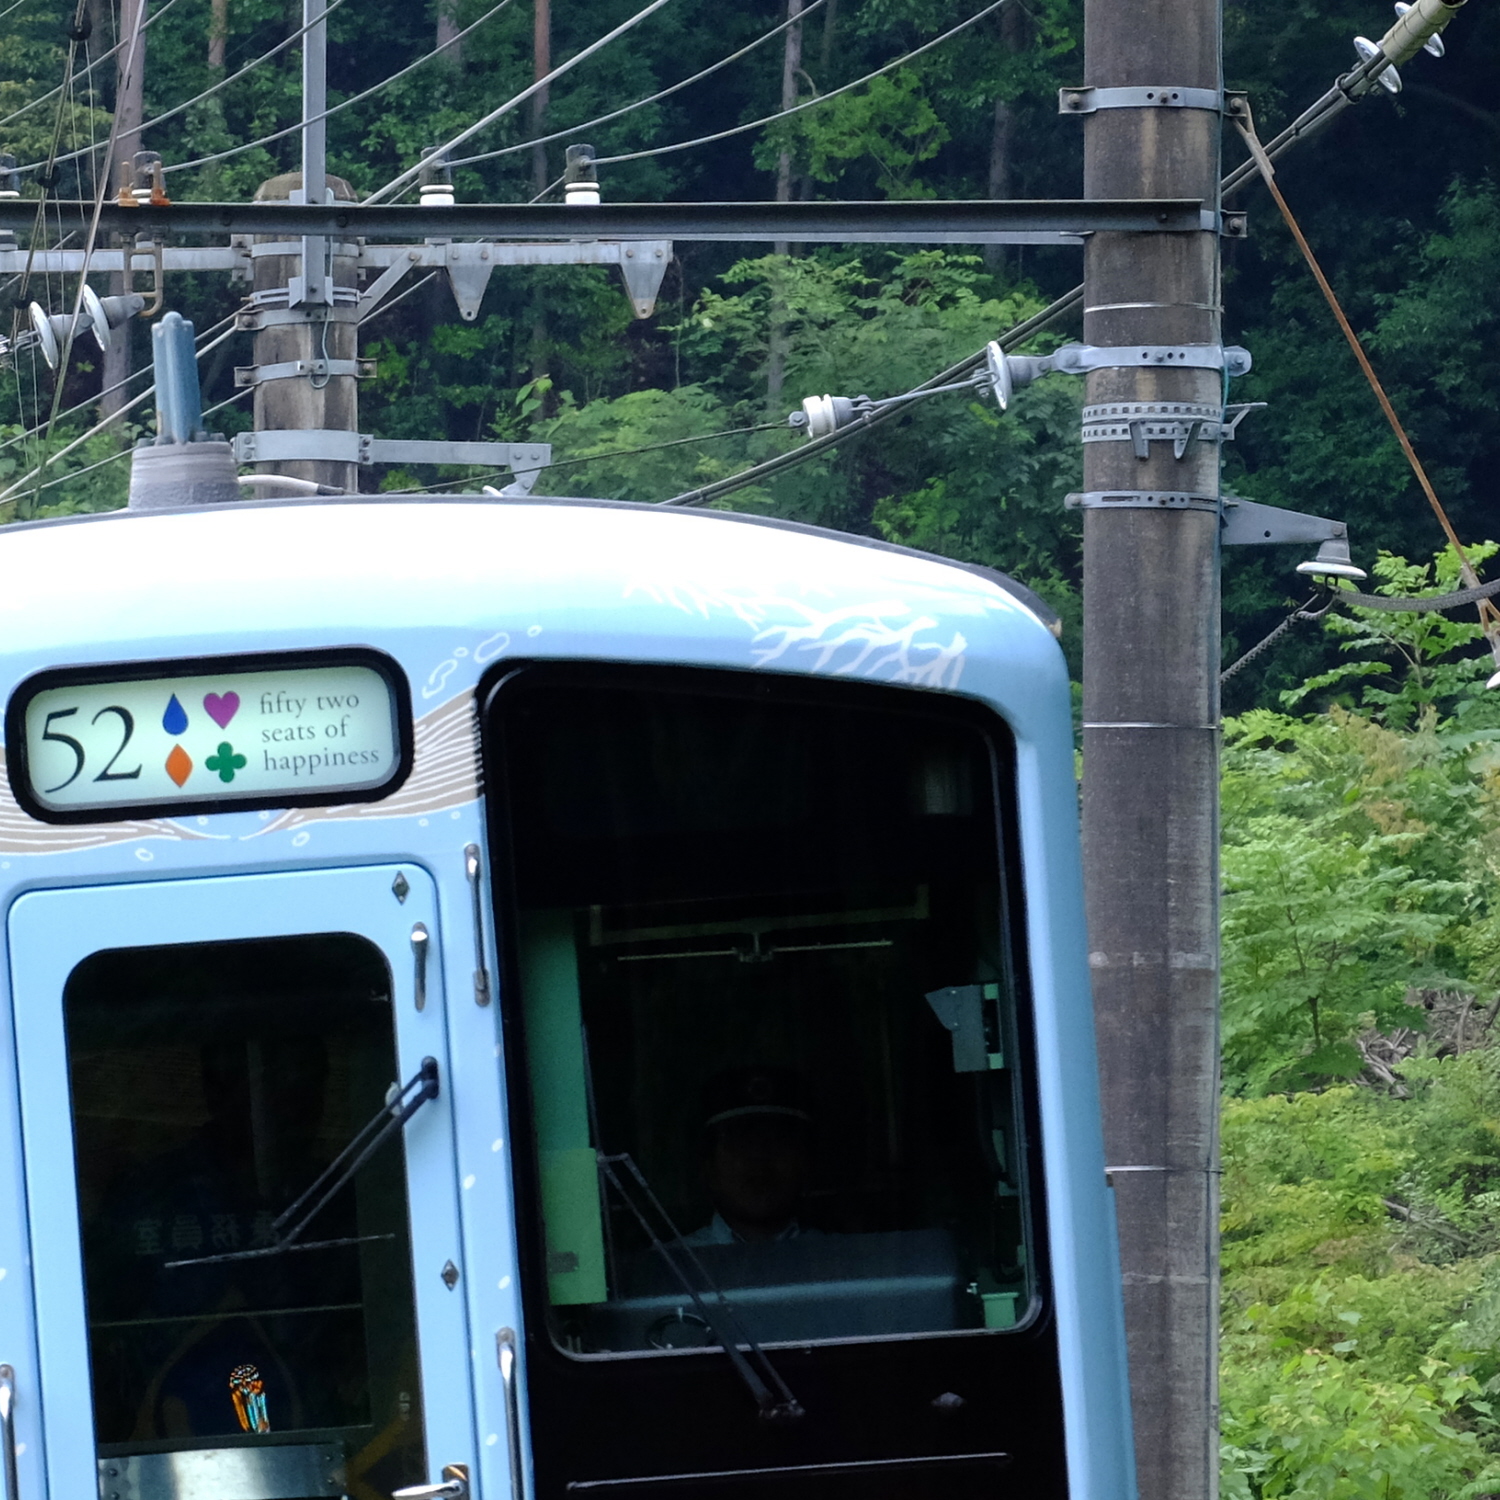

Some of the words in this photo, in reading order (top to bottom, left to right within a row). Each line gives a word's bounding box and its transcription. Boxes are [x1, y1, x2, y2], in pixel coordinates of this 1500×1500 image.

[259, 690, 307, 716] fifty
[316, 692, 360, 711] two
[261, 723, 316, 743] seats
[325, 716, 351, 739] of
[41, 704, 143, 794] 52
[263, 746, 380, 776] happiness
